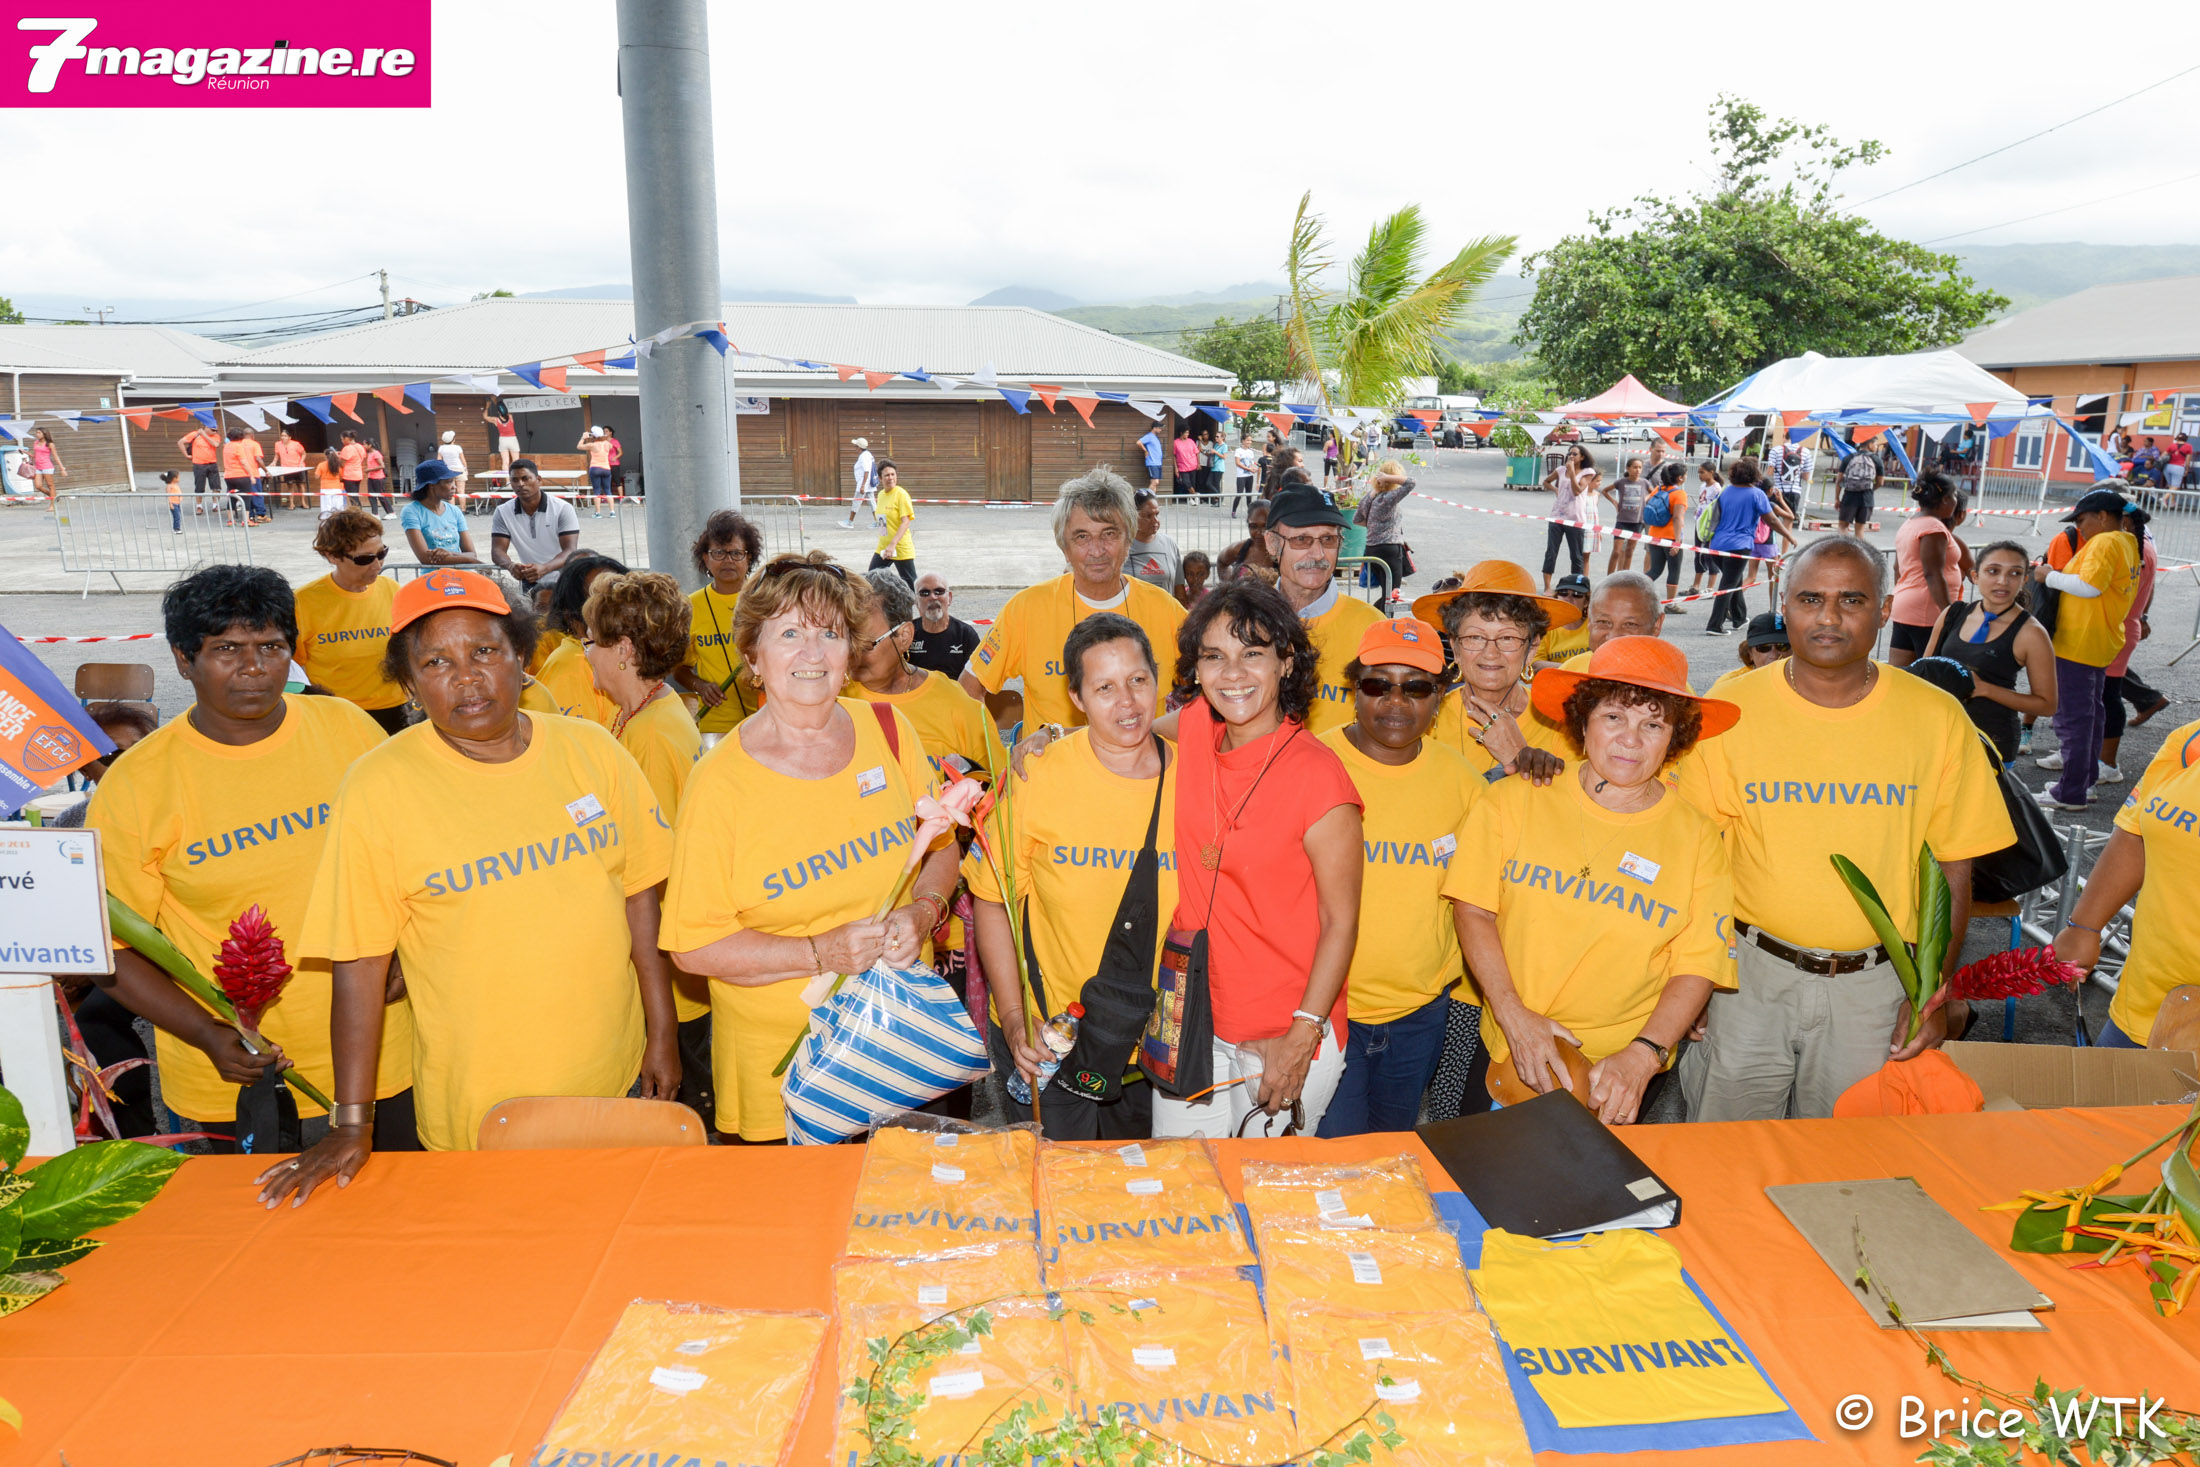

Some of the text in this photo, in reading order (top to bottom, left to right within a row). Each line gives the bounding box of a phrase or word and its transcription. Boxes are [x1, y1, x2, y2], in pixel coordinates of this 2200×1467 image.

[538, 399, 551, 408] LO
[556, 397, 577, 407] KER
[696, 632, 736, 647] SURV
[34, 733, 72, 762] EFCC
[1744, 781, 1918, 807] SURVIVANT
[2144, 796, 2200, 837] SUR
[186, 802, 331, 866] SURVIVA
[424, 822, 619, 897] SURVIVANT
[1053, 845, 1178, 872] SURVIA
[1501, 859, 1678, 929] SURVIVANT
[0, 941, 95, 964] vivants
[1080, 1072, 1103, 1092] 974
[1514, 1338, 1746, 1377] SURVIVANT
